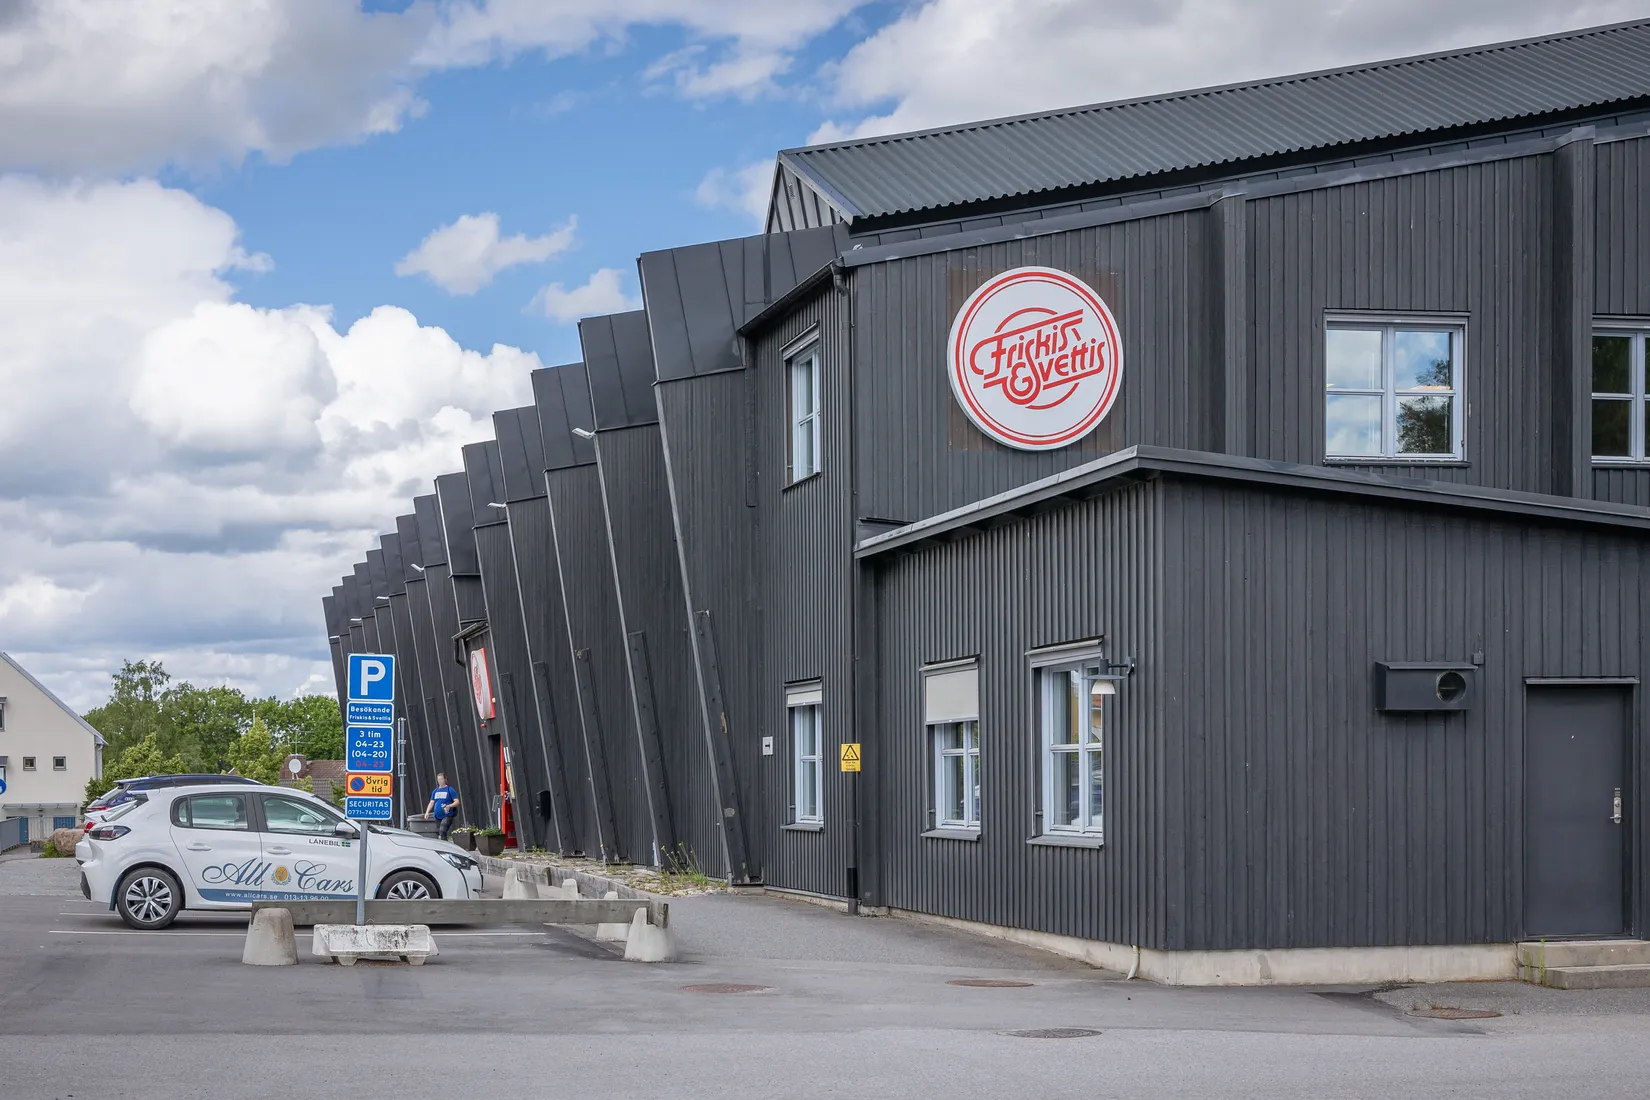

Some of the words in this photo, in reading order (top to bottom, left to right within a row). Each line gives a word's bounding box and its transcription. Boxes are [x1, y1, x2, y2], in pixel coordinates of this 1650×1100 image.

[970, 309, 1084, 382] Friskis
[361, 660, 386, 695] P
[360, 730, 365, 738] 3
[368, 730, 381, 738] tim
[355, 740, 384, 748] 04-23
[352, 750, 388, 758] (04-20)
[355, 760, 385, 768] 04-23
[366, 776, 389, 786] Övrig
[348, 800, 389, 808] SECURITAS
[201, 857, 273, 887] All
[294, 859, 354, 893] Cars
[225, 891, 278, 900] www.allcars.se
